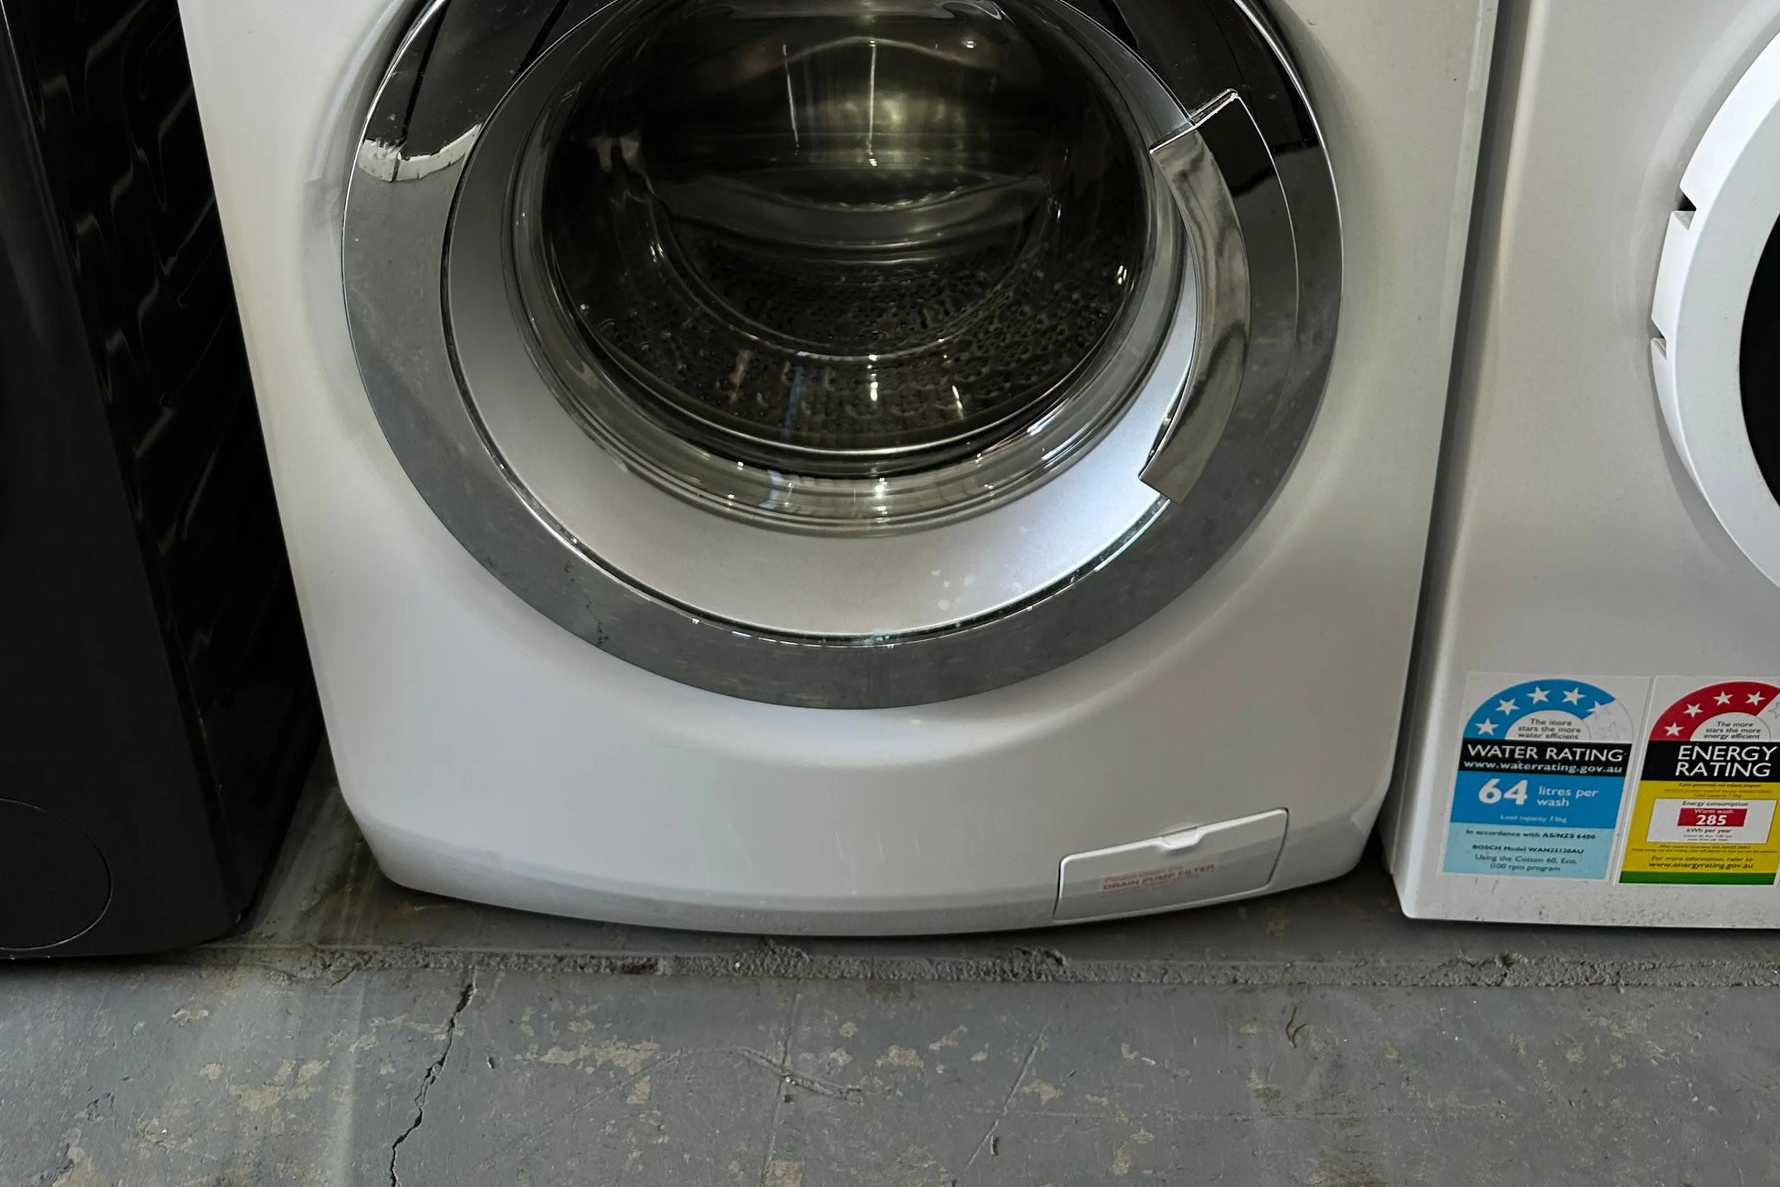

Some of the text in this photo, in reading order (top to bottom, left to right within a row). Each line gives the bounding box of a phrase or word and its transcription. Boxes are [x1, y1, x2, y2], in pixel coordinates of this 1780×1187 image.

[1468, 744, 1624, 762] WATER RATING
[1677, 745, 1778, 761] ENERGY
[1463, 760, 1623, 774] www.waterrating.gov.au
[1675, 762, 1772, 777] RATING
[1478, 778, 1599, 806] 64 litres per
[1536, 798, 1570, 807] wash
[1696, 814, 1727, 826] 285
[1475, 854, 1497, 862] Using
[1103, 880, 1140, 890] DRAIN
